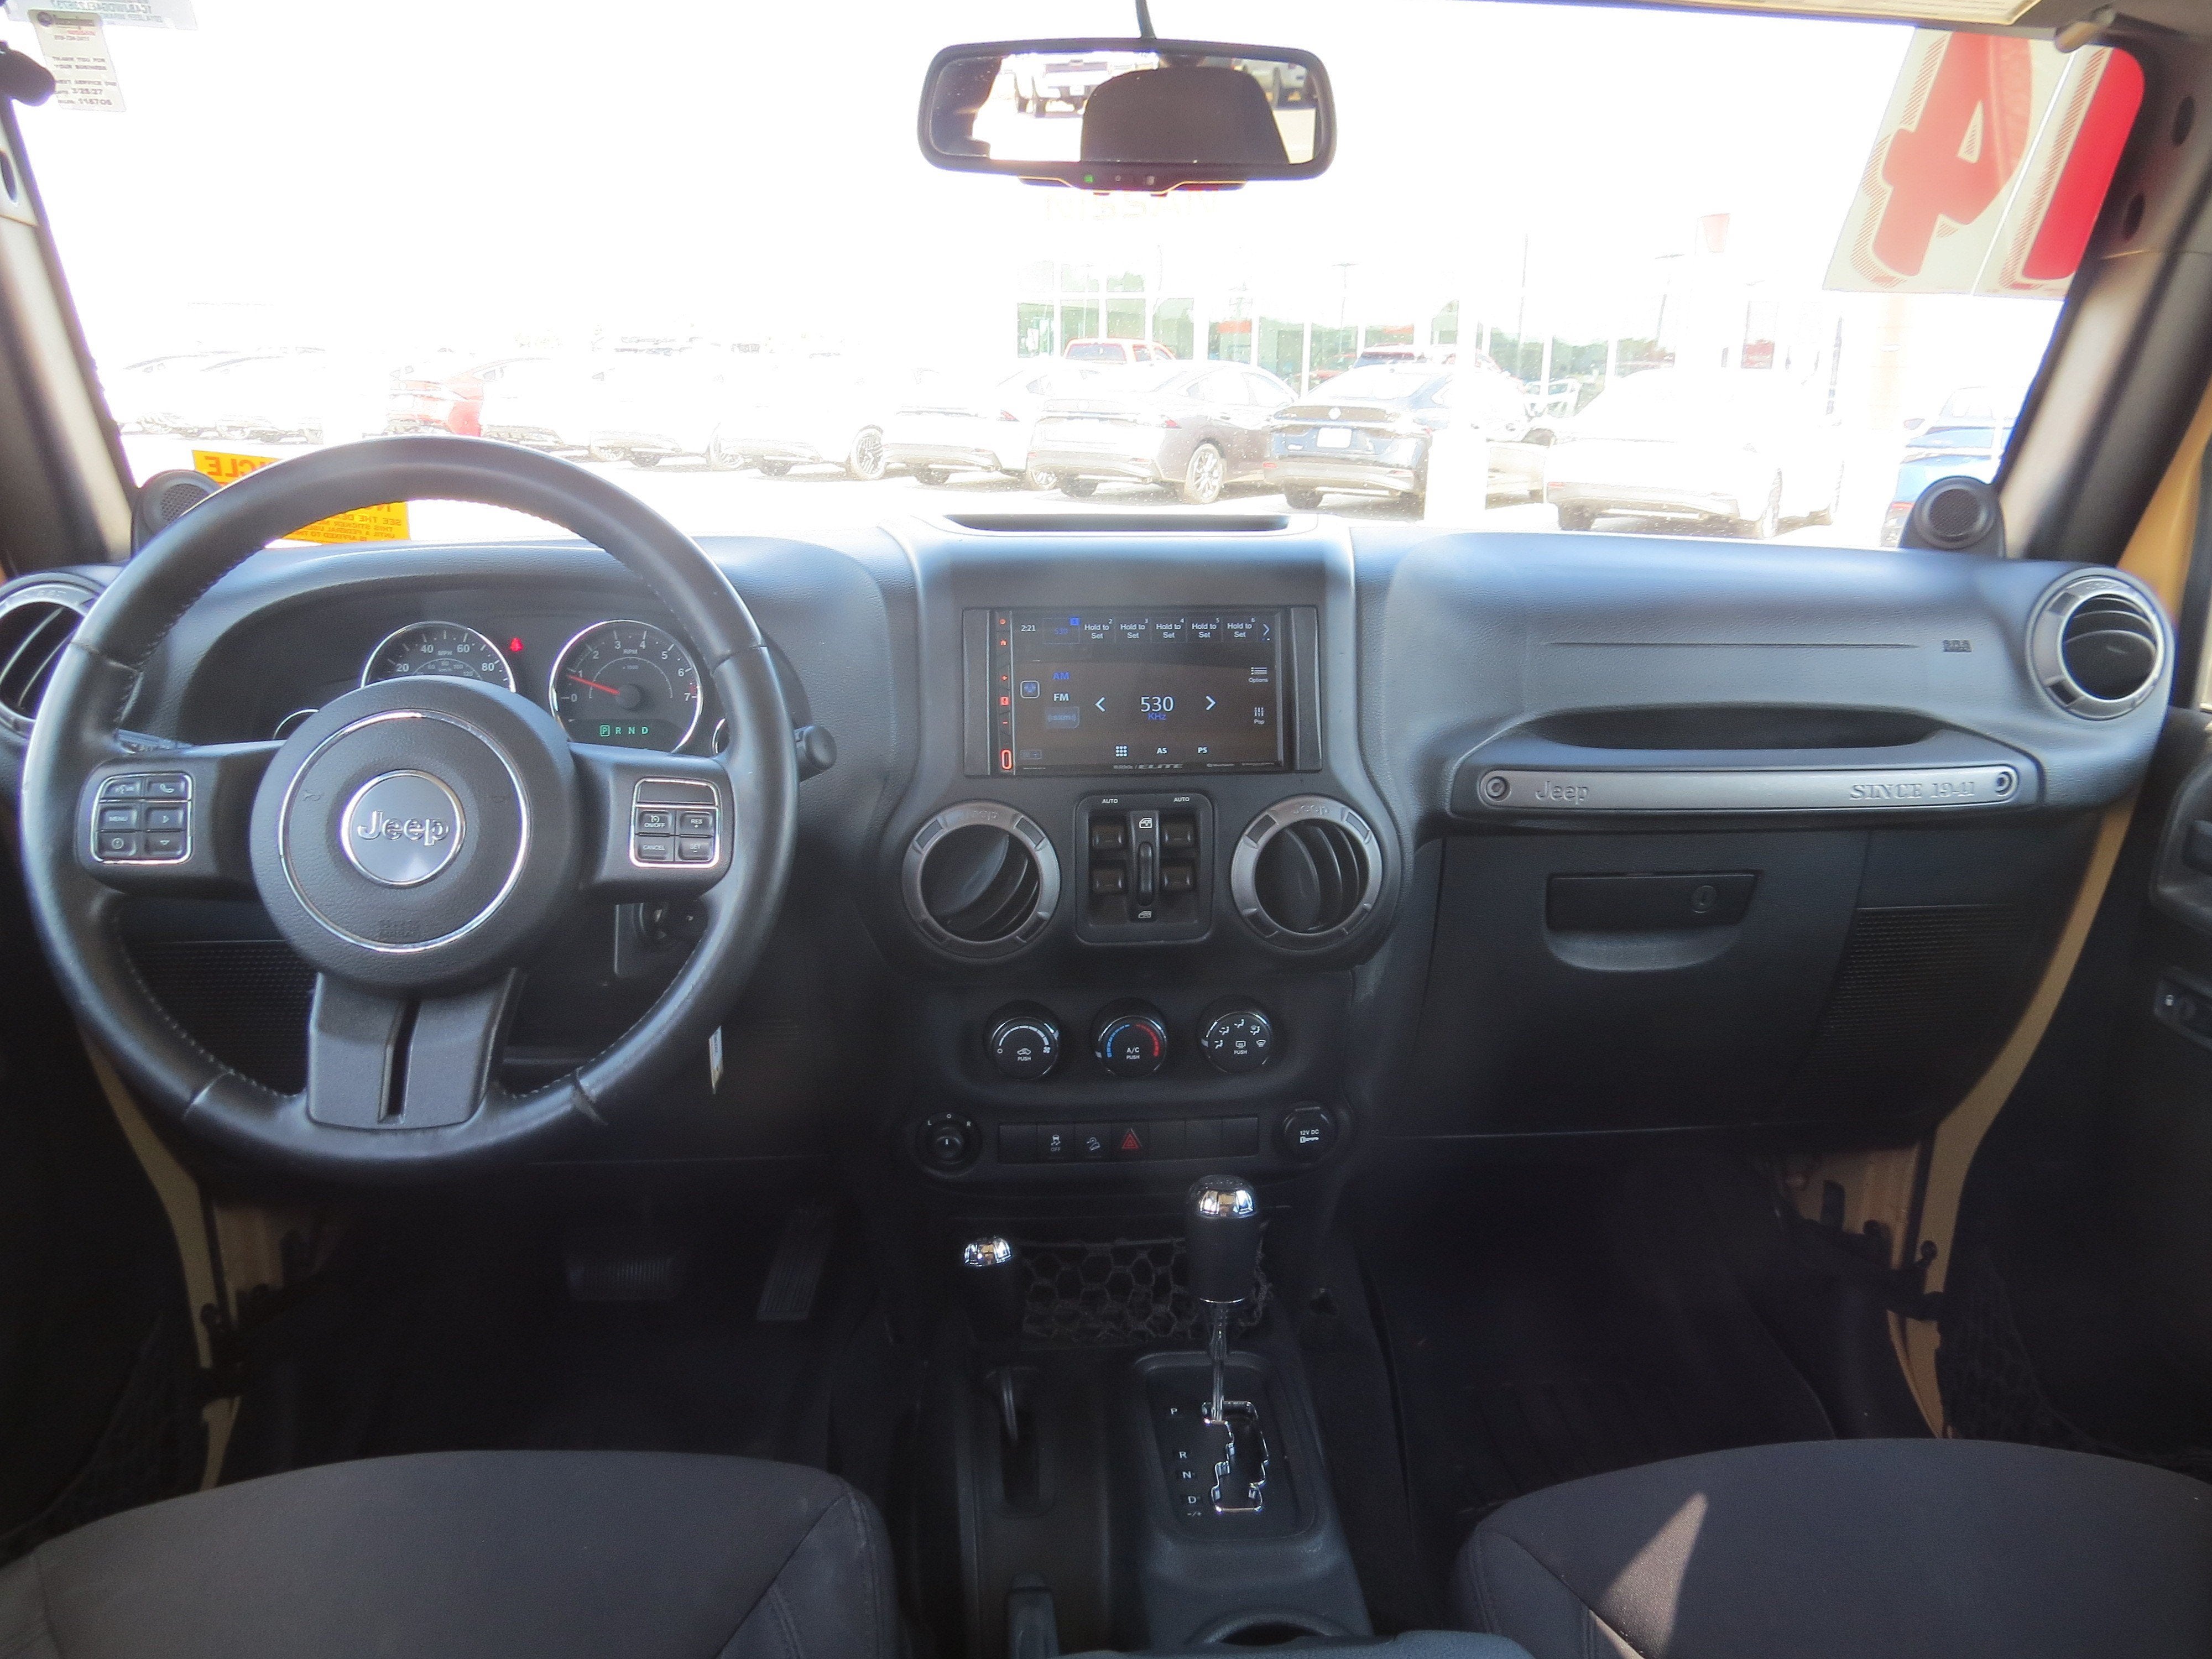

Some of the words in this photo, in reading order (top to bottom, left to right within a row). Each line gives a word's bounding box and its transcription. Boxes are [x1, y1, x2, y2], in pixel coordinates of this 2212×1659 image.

[421, 644, 434, 653] 40
[457, 643, 469, 653] 60
[615, 640, 621, 649] 3
[640, 640, 646, 649] 4
[593, 651, 599, 659] 2
[661, 651, 668, 660] 5
[396, 663, 409, 672] 20
[482, 662, 494, 671] 80
[677, 668, 685, 676] 6
[1053, 671, 1070, 680] AM
[571, 693, 577, 702] 0
[684, 692, 690, 701] 7
[1053, 693, 1070, 701] FM
[1140, 696, 1175, 713] 530
[1535, 780, 1588, 805] Jeep
[1849, 783, 1922, 800] SINCE
[1929, 781, 1975, 799] 1941
[357, 810, 450, 846] Jeep
